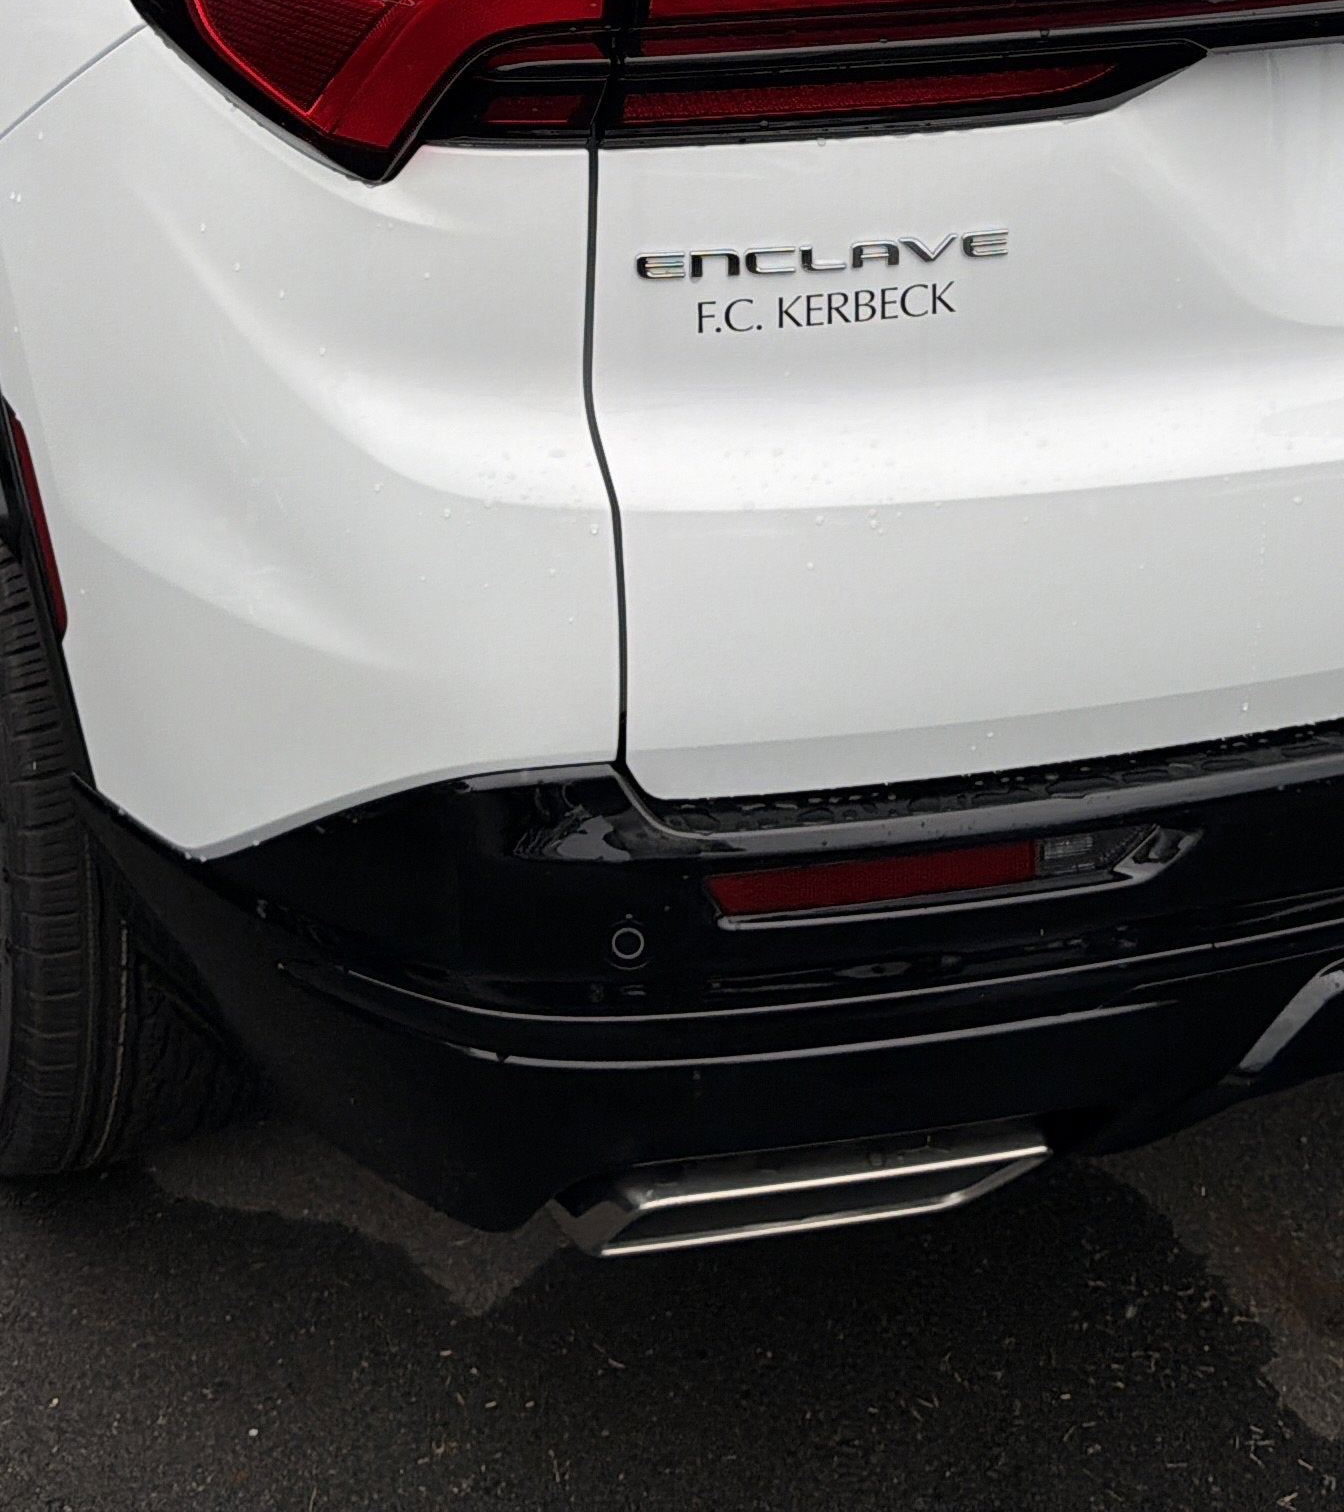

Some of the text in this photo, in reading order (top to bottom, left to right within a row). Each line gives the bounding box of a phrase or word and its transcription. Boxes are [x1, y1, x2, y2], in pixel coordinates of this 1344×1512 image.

[635, 227, 1010, 281] ENCLAVE
[696, 280, 957, 335] F.C. KERBECK
